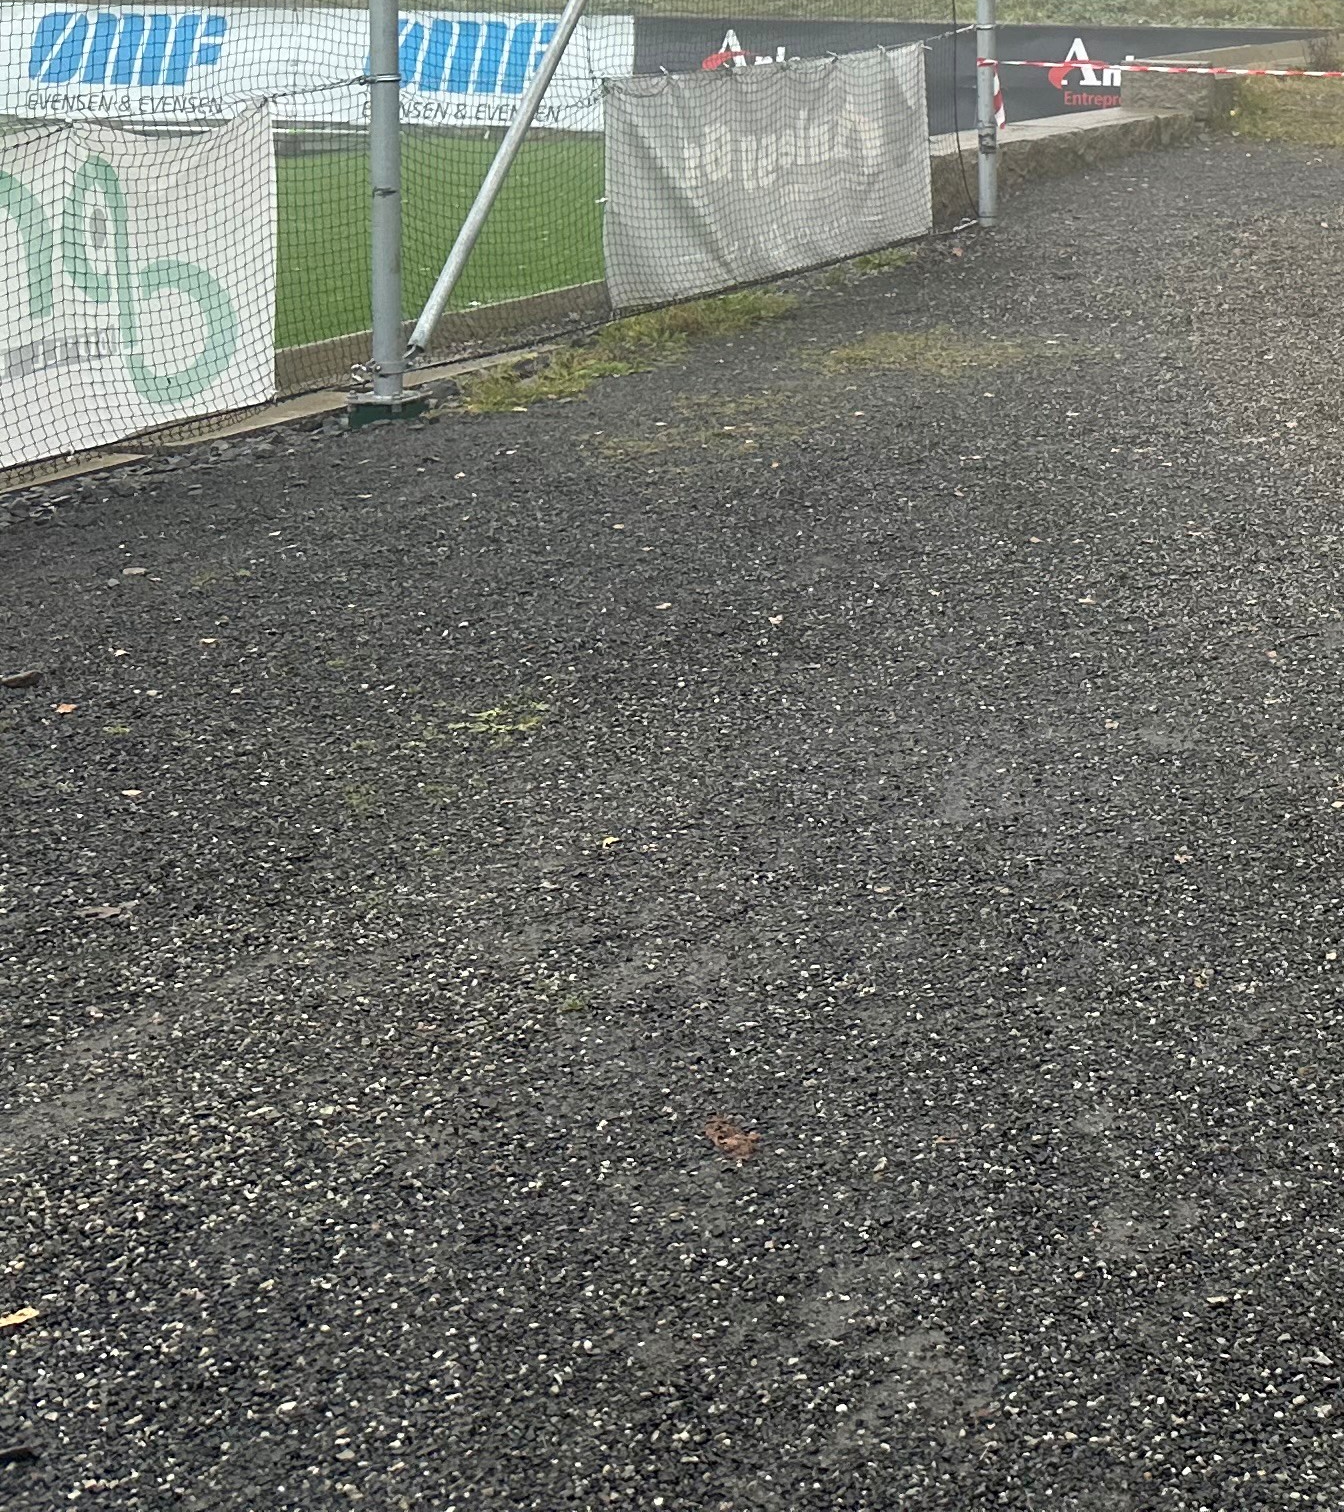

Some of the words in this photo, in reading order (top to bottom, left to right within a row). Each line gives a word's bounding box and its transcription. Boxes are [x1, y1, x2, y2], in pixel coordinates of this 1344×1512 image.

[28, 92, 113, 112] EVENSEN
[117, 94, 131, 112] &
[362, 100, 449, 120] ENSEN
[453, 102, 467, 120] &
[475, 103, 561, 123] EVENEN
